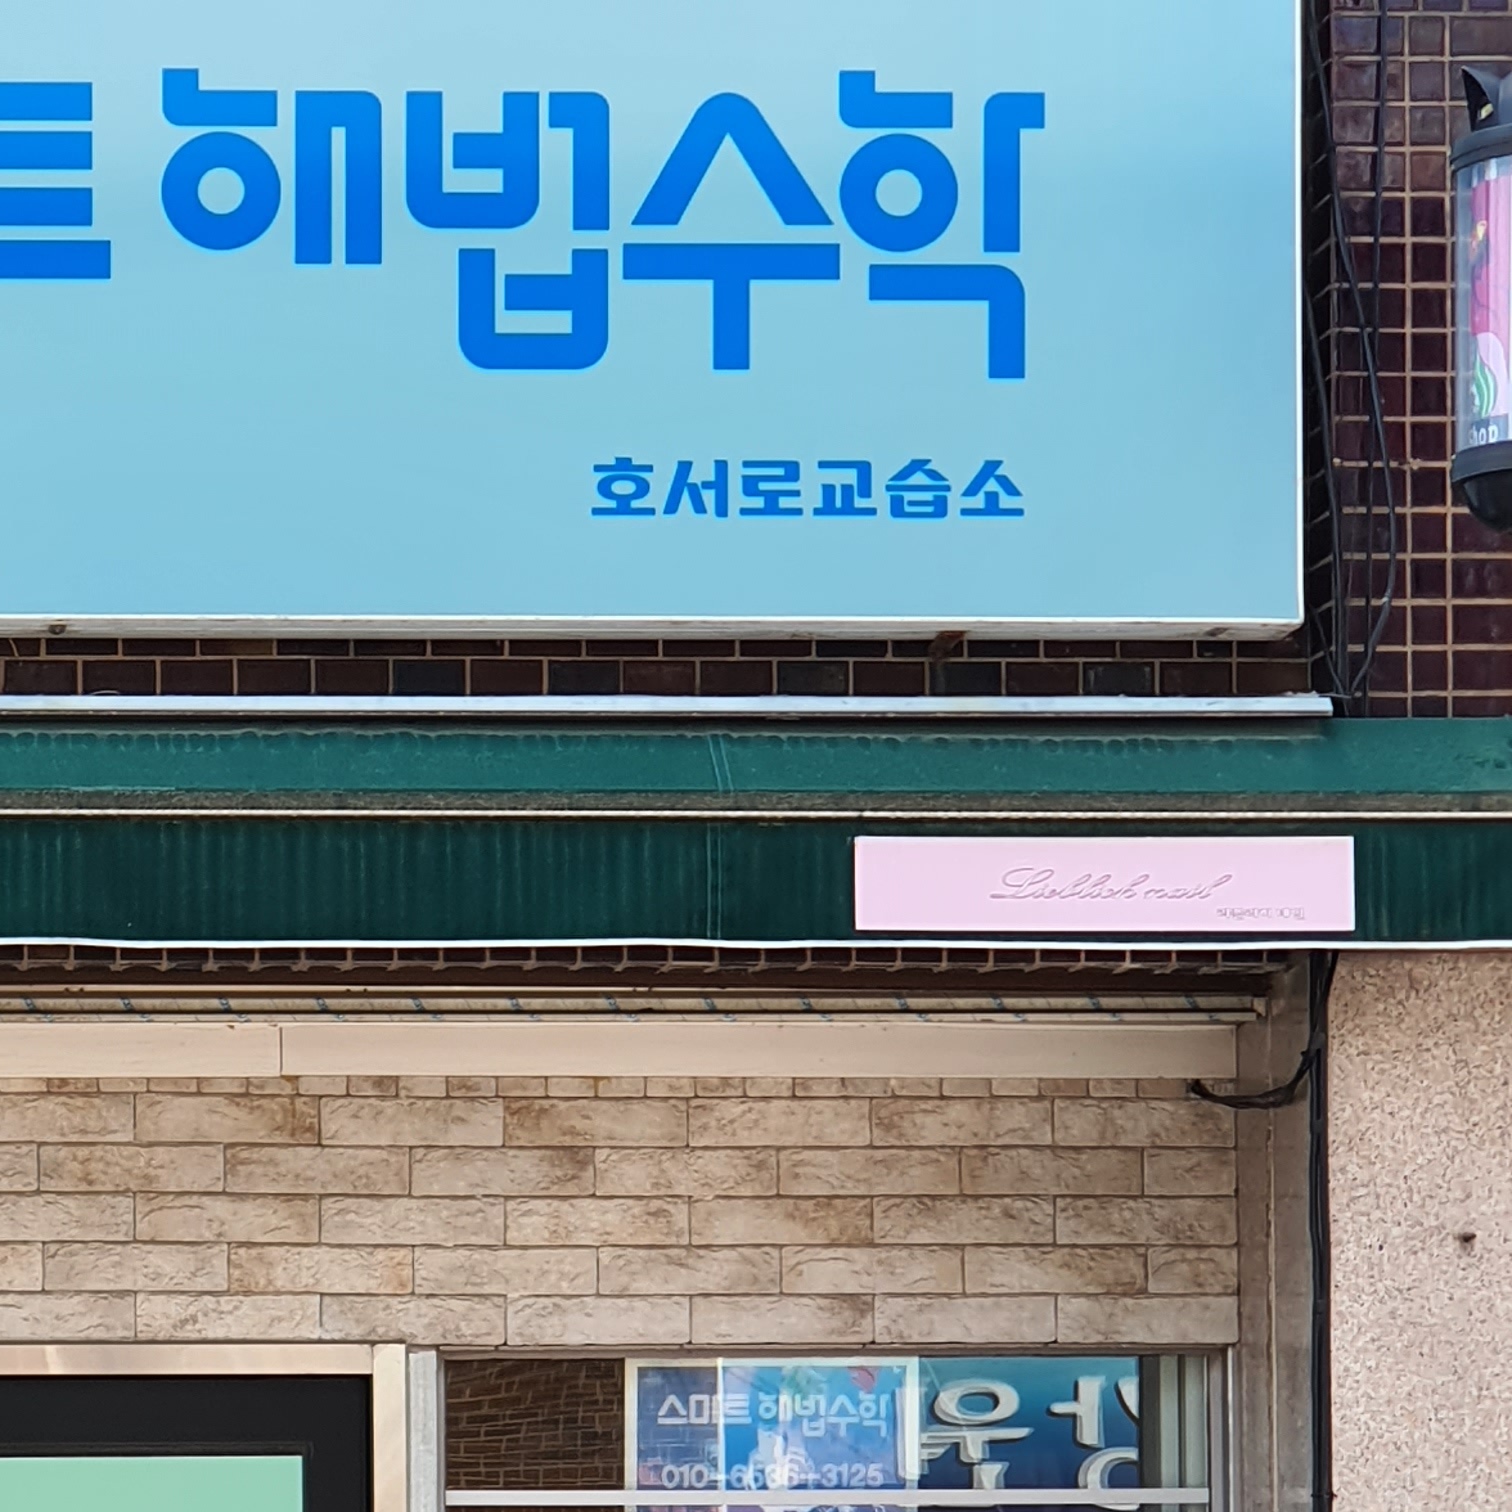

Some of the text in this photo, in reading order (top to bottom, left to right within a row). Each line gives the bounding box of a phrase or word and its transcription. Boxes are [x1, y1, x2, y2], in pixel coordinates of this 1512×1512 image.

[160, 66, 1047, 380] 해법수학
[591, 456, 1027, 520] 호서로교습소
[657, 1393, 752, 1425] 스마트
